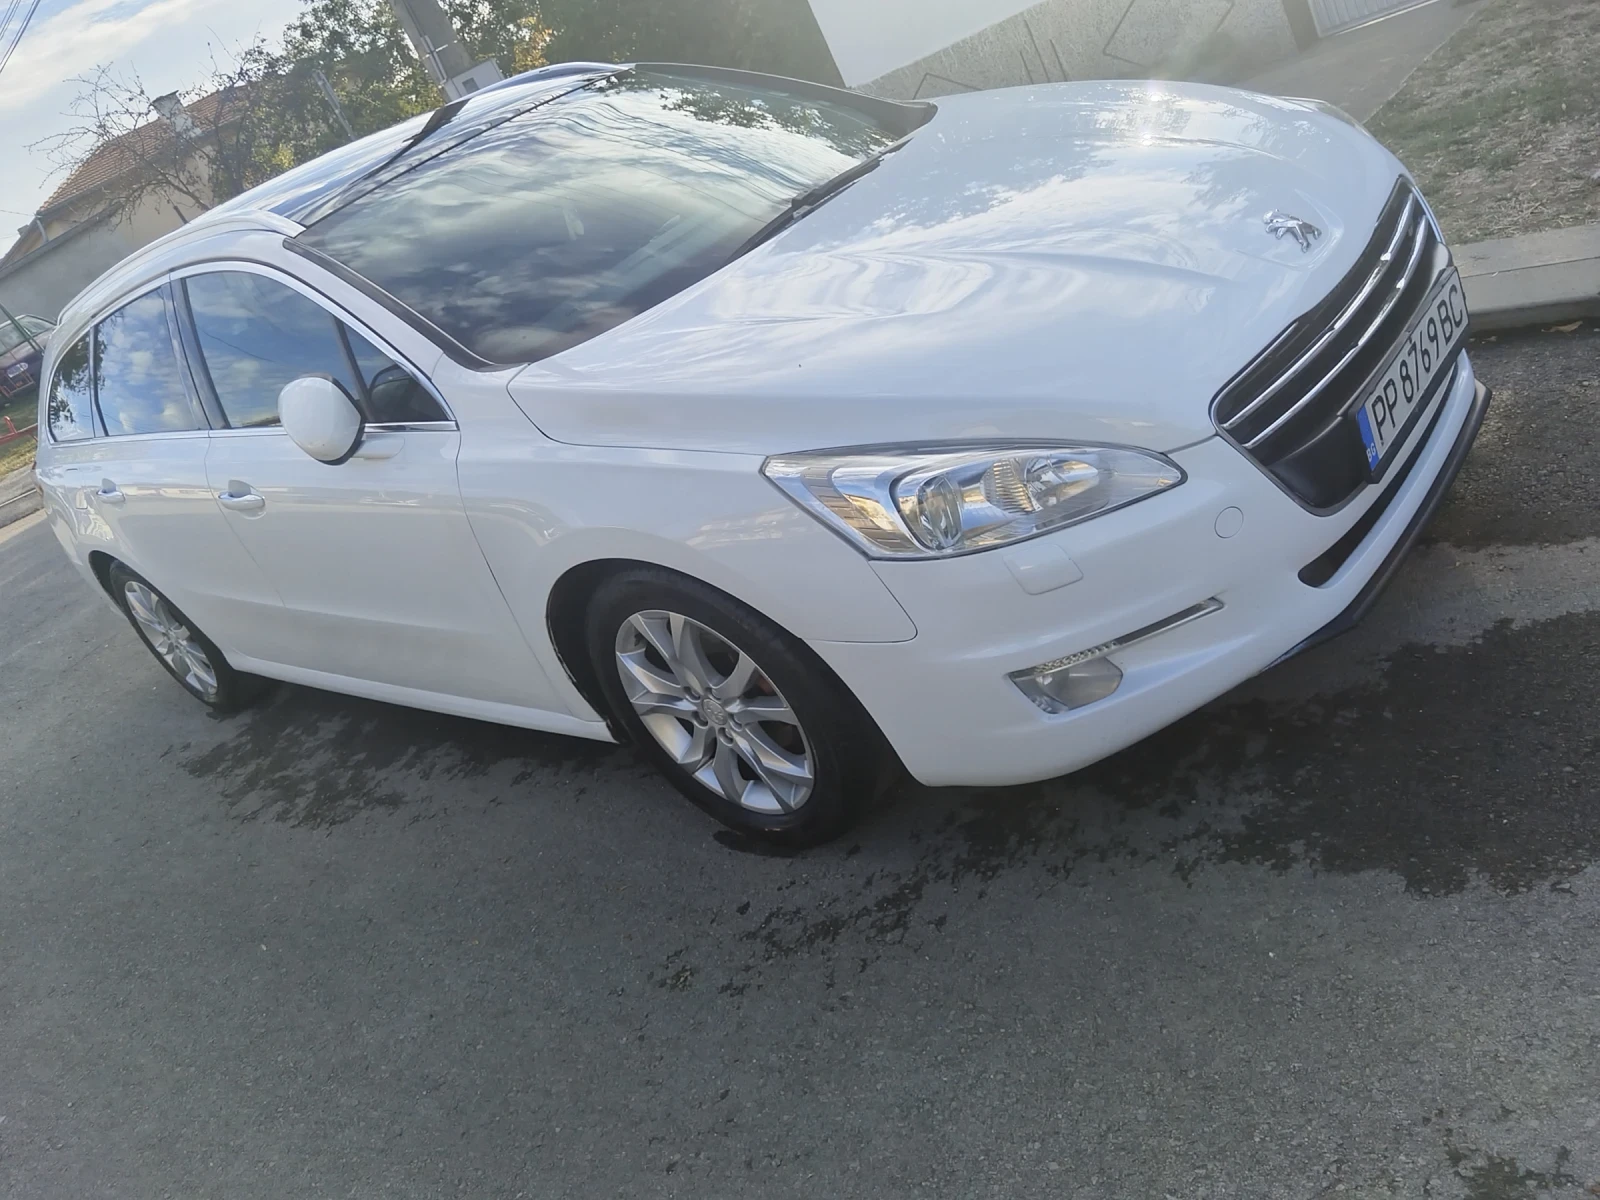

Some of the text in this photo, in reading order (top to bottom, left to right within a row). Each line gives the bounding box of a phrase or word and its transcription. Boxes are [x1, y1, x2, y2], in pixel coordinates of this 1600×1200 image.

[1371, 284, 1463, 441] PP 8769 BC
[1366, 442, 1377, 462] BG
